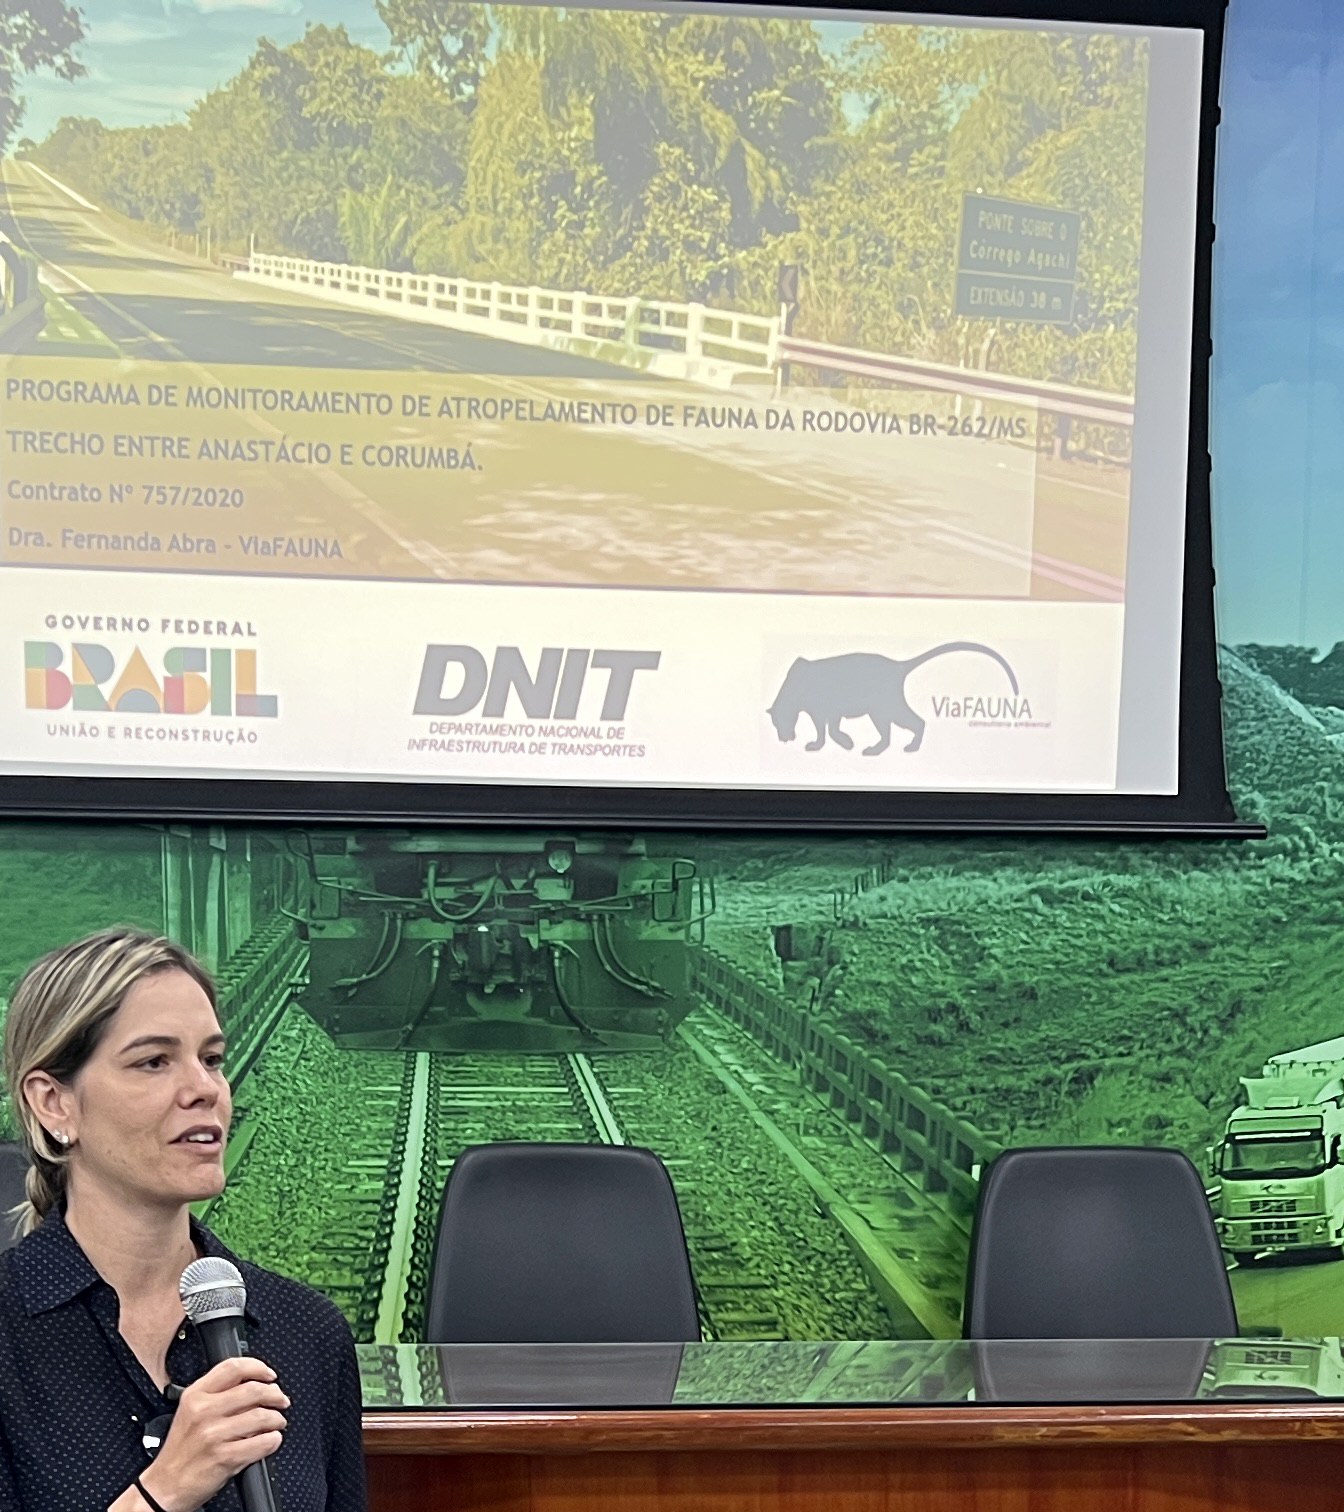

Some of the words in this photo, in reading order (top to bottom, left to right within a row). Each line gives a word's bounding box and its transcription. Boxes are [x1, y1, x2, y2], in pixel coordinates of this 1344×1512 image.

[6, 378, 141, 407] PROGRAMA
[147, 384, 178, 407] DE
[185, 386, 393, 417] MONITORAMENTO
[401, 394, 431, 418] DE
[437, 396, 637, 425] ATROPELAMENTO
[645, 404, 675, 427] DE
[682, 406, 759, 431] FAUNA
[765, 408, 796, 432] DA
[802, 410, 902, 436] RODOVIA
[908, 414, 1027, 441] BR-262/MS
[5, 430, 105, 456] TRECHO
[113, 434, 191, 459] ENTRE
[197, 434, 332, 465] ANASTÁCIO
[340, 443, 353, 466] E
[361, 441, 484, 471] CORUMBÁ.
[7, 479, 103, 503] Contrato
[142, 485, 245, 509] 757/2020
[8, 526, 52, 548] Dra.
[61, 528, 161, 553] Fernanda
[167, 532, 217, 554] Abra
[239, 535, 344, 559] ViaFAUNA
[44, 614, 151, 633] GOVERNO
[160, 618, 258, 637] FEDERAL
[23, 640, 279, 719] BRASIL
[412, 643, 662, 722] DNIT
[931, 696, 1033, 719] ViaFAUNA
[46, 722, 100, 738] UNIÃO
[107, 726, 117, 739] E
[123, 726, 259, 746] RECONSTRUÇÃO
[428, 721, 536, 738] DEPARTAMENTO
[537, 725, 604, 740] NACIONAL
[606, 727, 626, 740] DE
[406, 738, 526, 755] INFRAESTRUTURA
[528, 742, 548, 755] DE
[550, 742, 646, 758] TRANSPORTES
